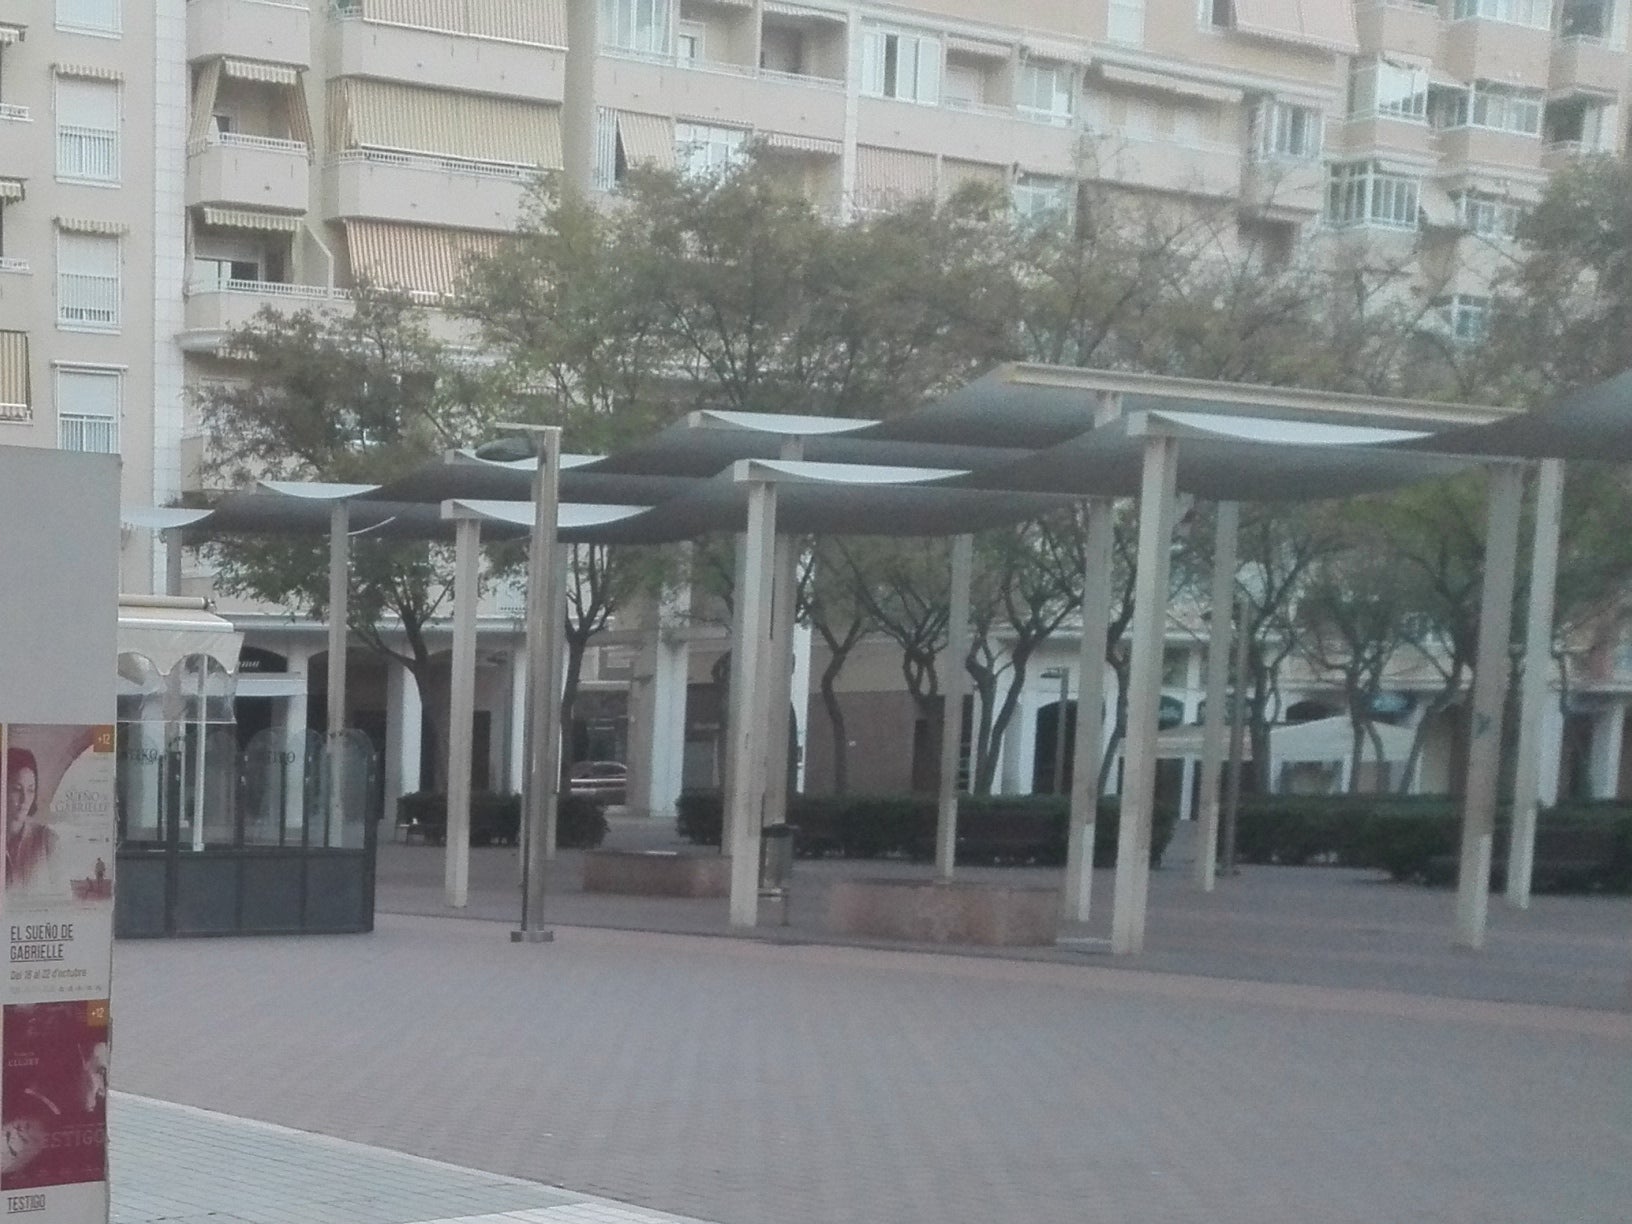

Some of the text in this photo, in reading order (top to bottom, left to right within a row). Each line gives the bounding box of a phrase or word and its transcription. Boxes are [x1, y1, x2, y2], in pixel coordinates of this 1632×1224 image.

[11, 923, 73, 941] EL SUEÑO DE
[10, 944, 63, 960] GABRIELLE
[7, 1194, 46, 1211] TESTIGO
